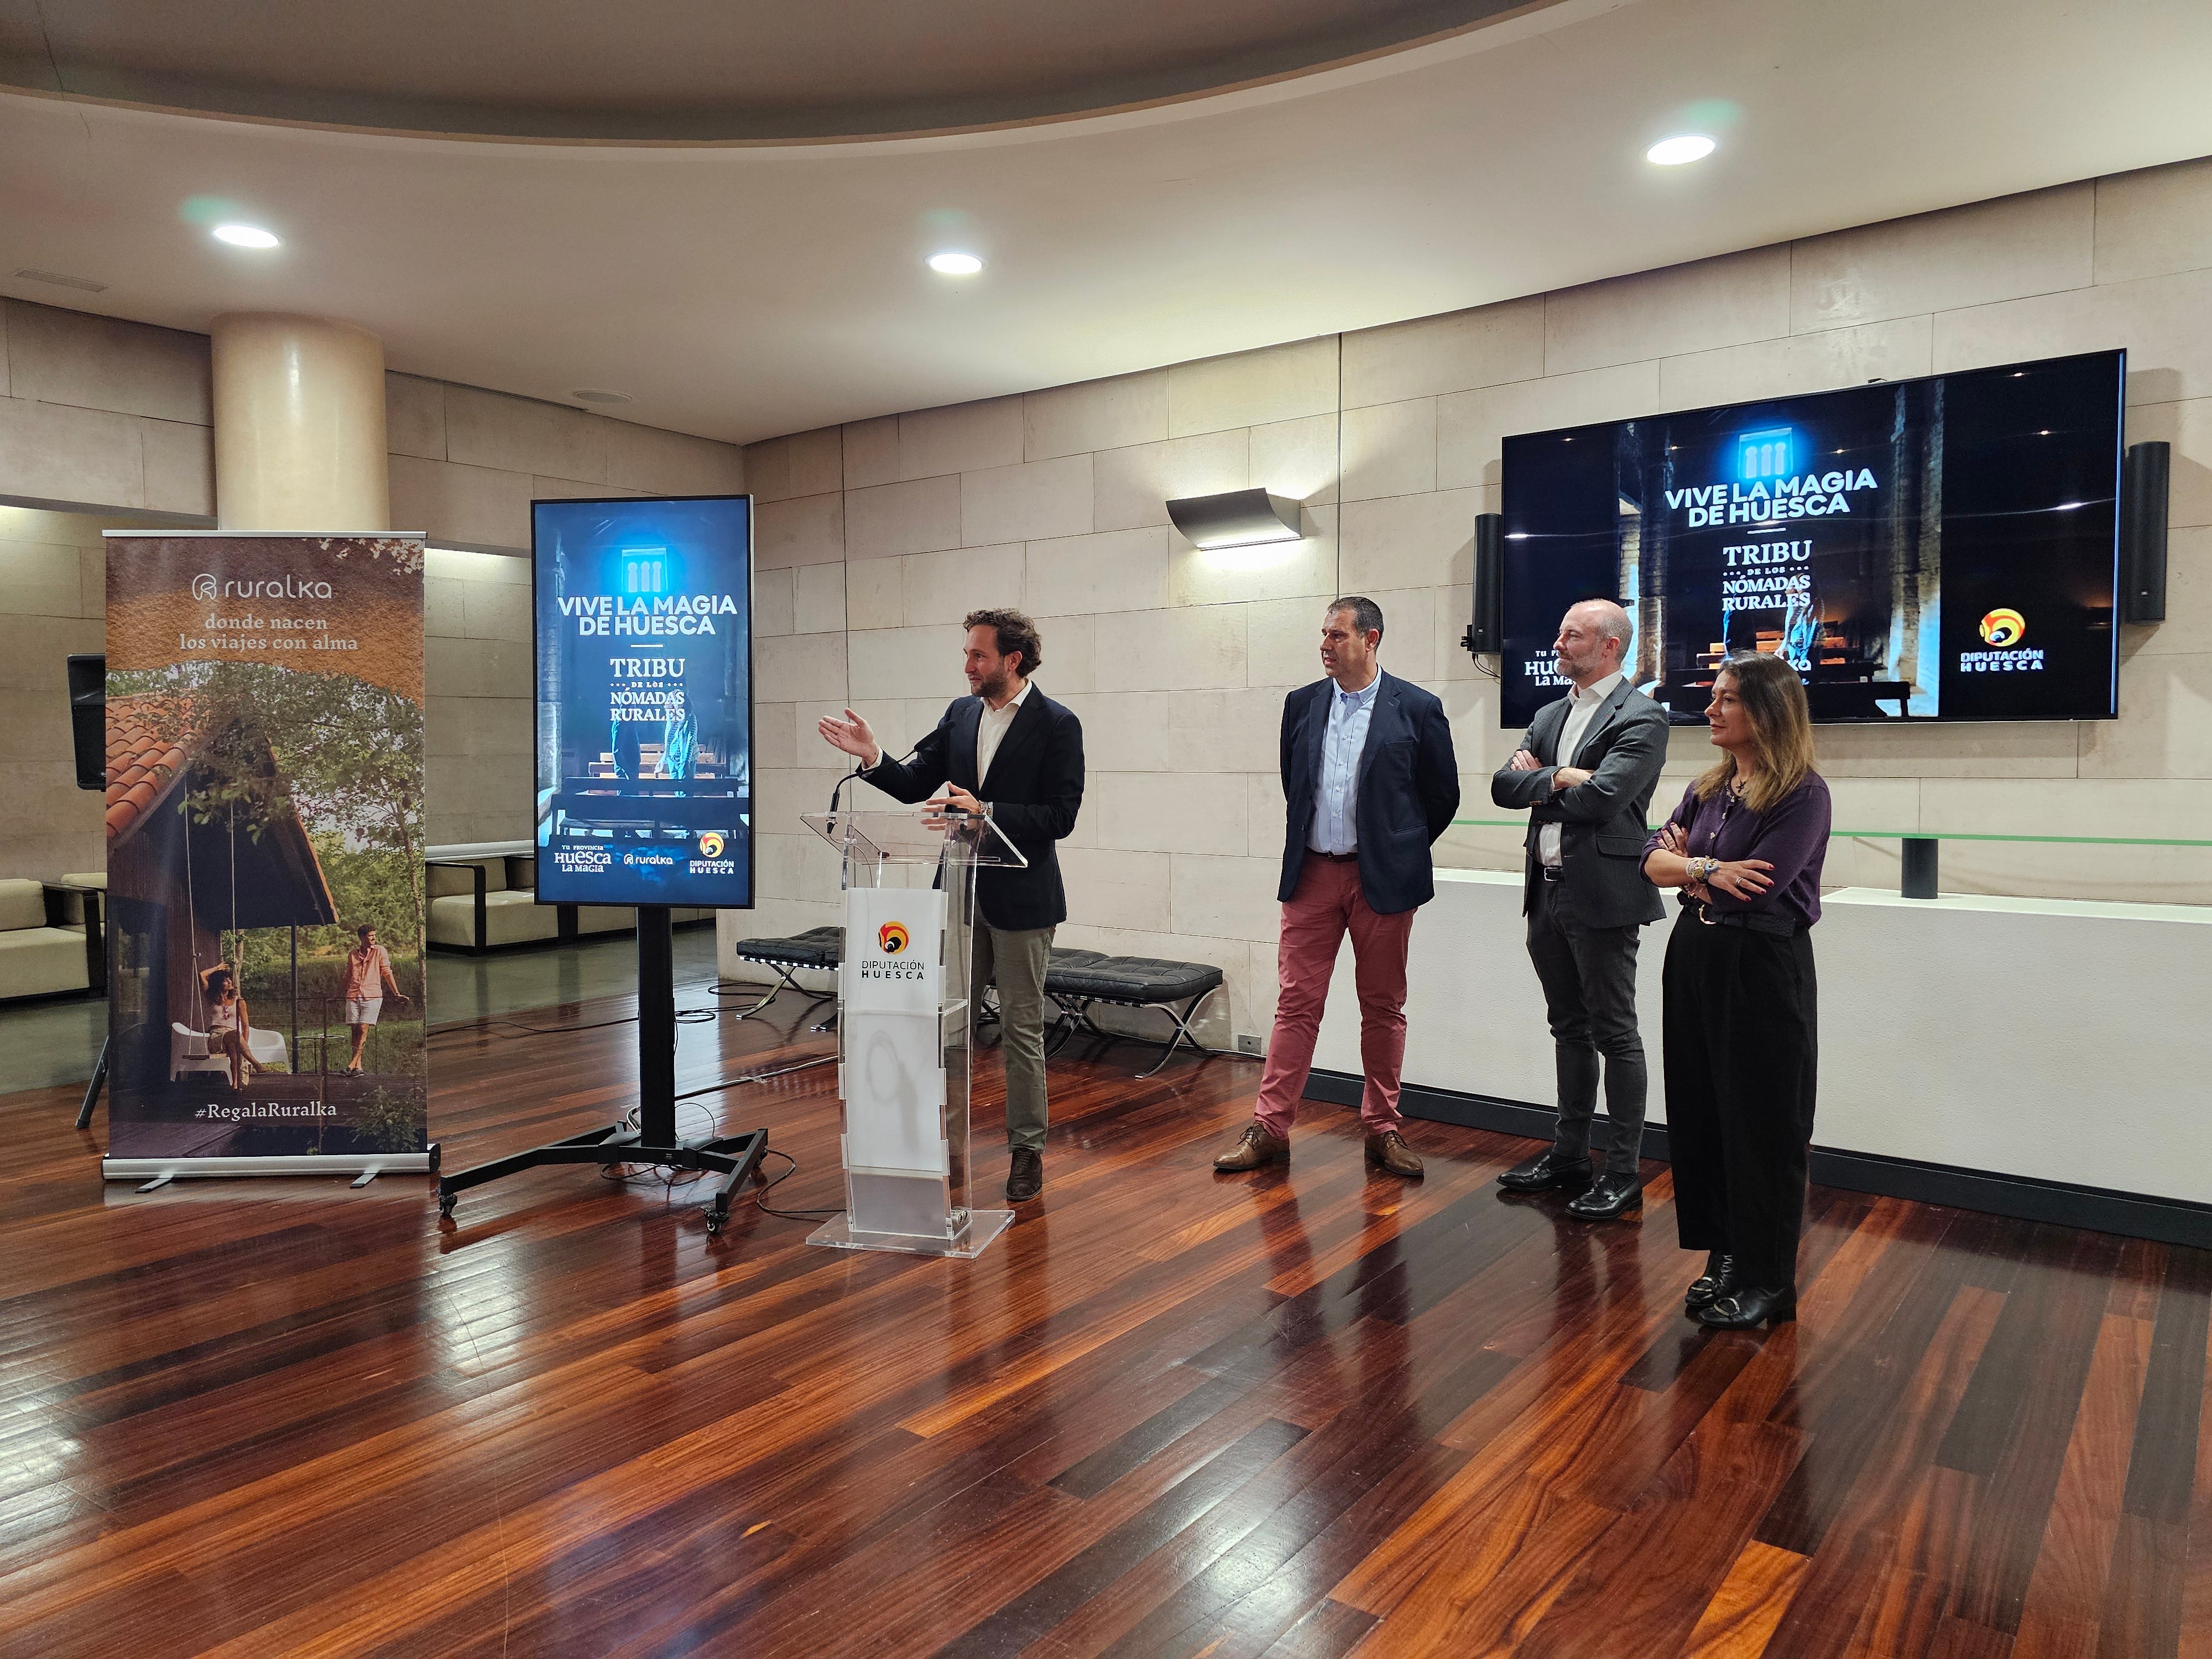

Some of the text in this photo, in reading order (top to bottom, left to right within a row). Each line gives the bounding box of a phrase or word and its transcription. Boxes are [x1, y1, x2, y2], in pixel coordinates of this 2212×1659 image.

[1665, 468, 1878, 509] VIVE LA MAGIA
[1688, 493, 1850, 528] DE HUESCA
[1723, 540, 1812, 566] TRIBU
[225, 575, 332, 599] ruralka
[1723, 575, 1811, 594] NÓMADAS
[557, 594, 738, 616] VIVE LA MAGIA
[1722, 592, 1811, 611] RURALES
[205, 614, 328, 629] donde nacen
[580, 615, 716, 635] DE HUESCA
[180, 634, 358, 653] los viajes con alma
[1960, 648, 2043, 662] DIPUTACIÓN
[610, 658, 686, 677] TRIBU
[1960, 660, 2043, 672] HUESCA
[610, 687, 685, 705] NÓMADAS
[610, 708, 685, 722] RURALES
[635, 854, 673, 865] ruralka
[690, 859, 734, 868] DIPUTACIÓN
[862, 958, 924, 970] DIPUTACIÓN
[862, 970, 924, 979] HUESCA
[195, 1101, 337, 1121] #RegalaRuralka
